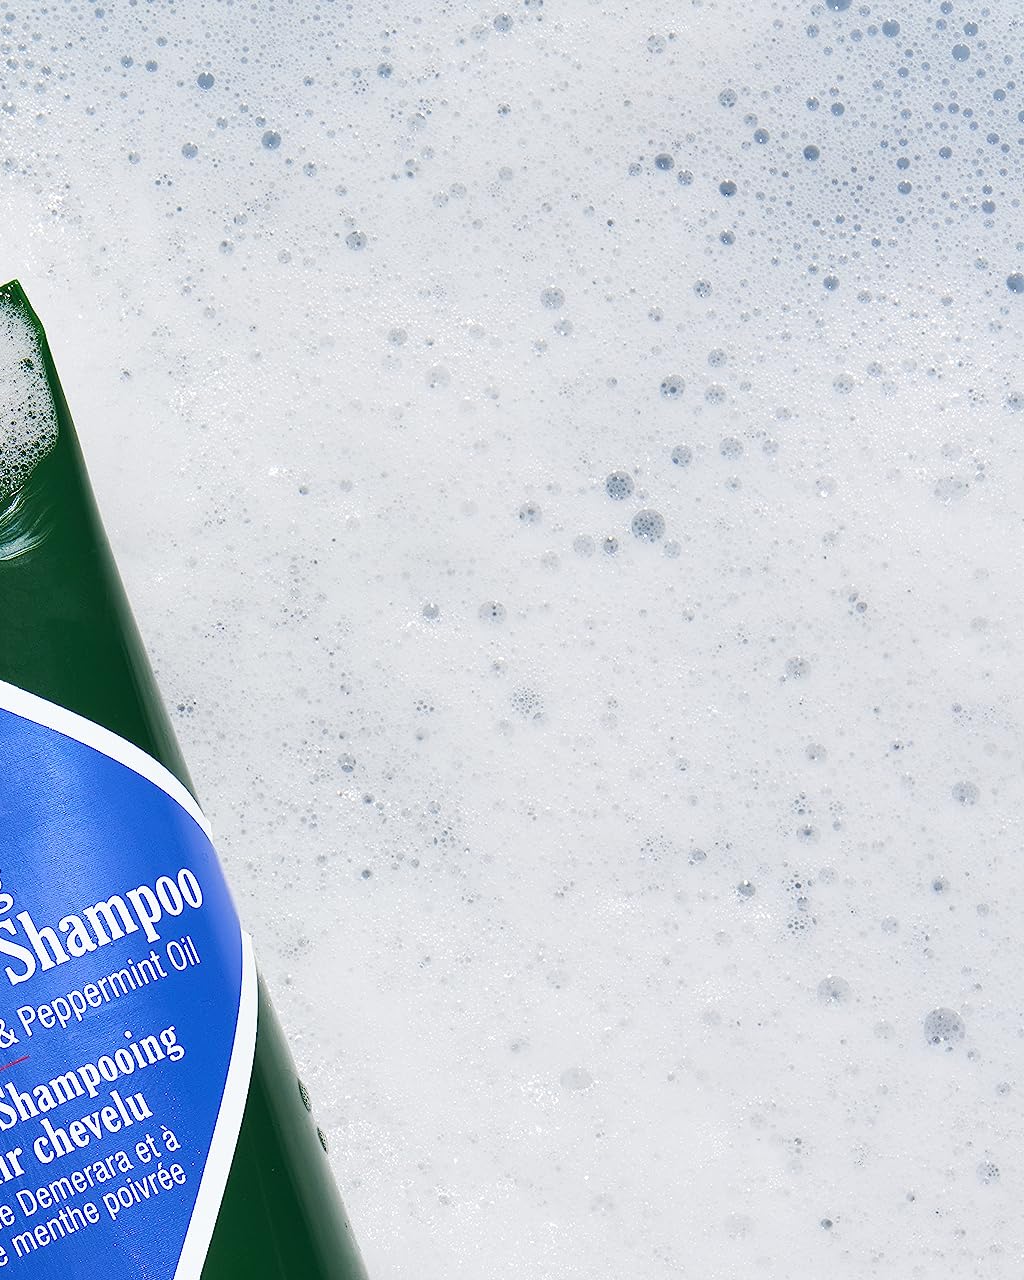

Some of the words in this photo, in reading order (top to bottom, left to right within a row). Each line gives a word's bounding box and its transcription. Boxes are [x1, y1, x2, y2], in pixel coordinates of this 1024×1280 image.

[17, 951, 167, 1036] Peppermint
[167, 936, 200, 970] Oil
[16, 1151, 134, 1216] Demerara
[136, 1134, 161, 1163] et
[160, 1125, 181, 1151] à
[34, 1090, 153, 1163] chevelu
[12, 1203, 99, 1257] menthe
[103, 1162, 186, 1220] poivrée
